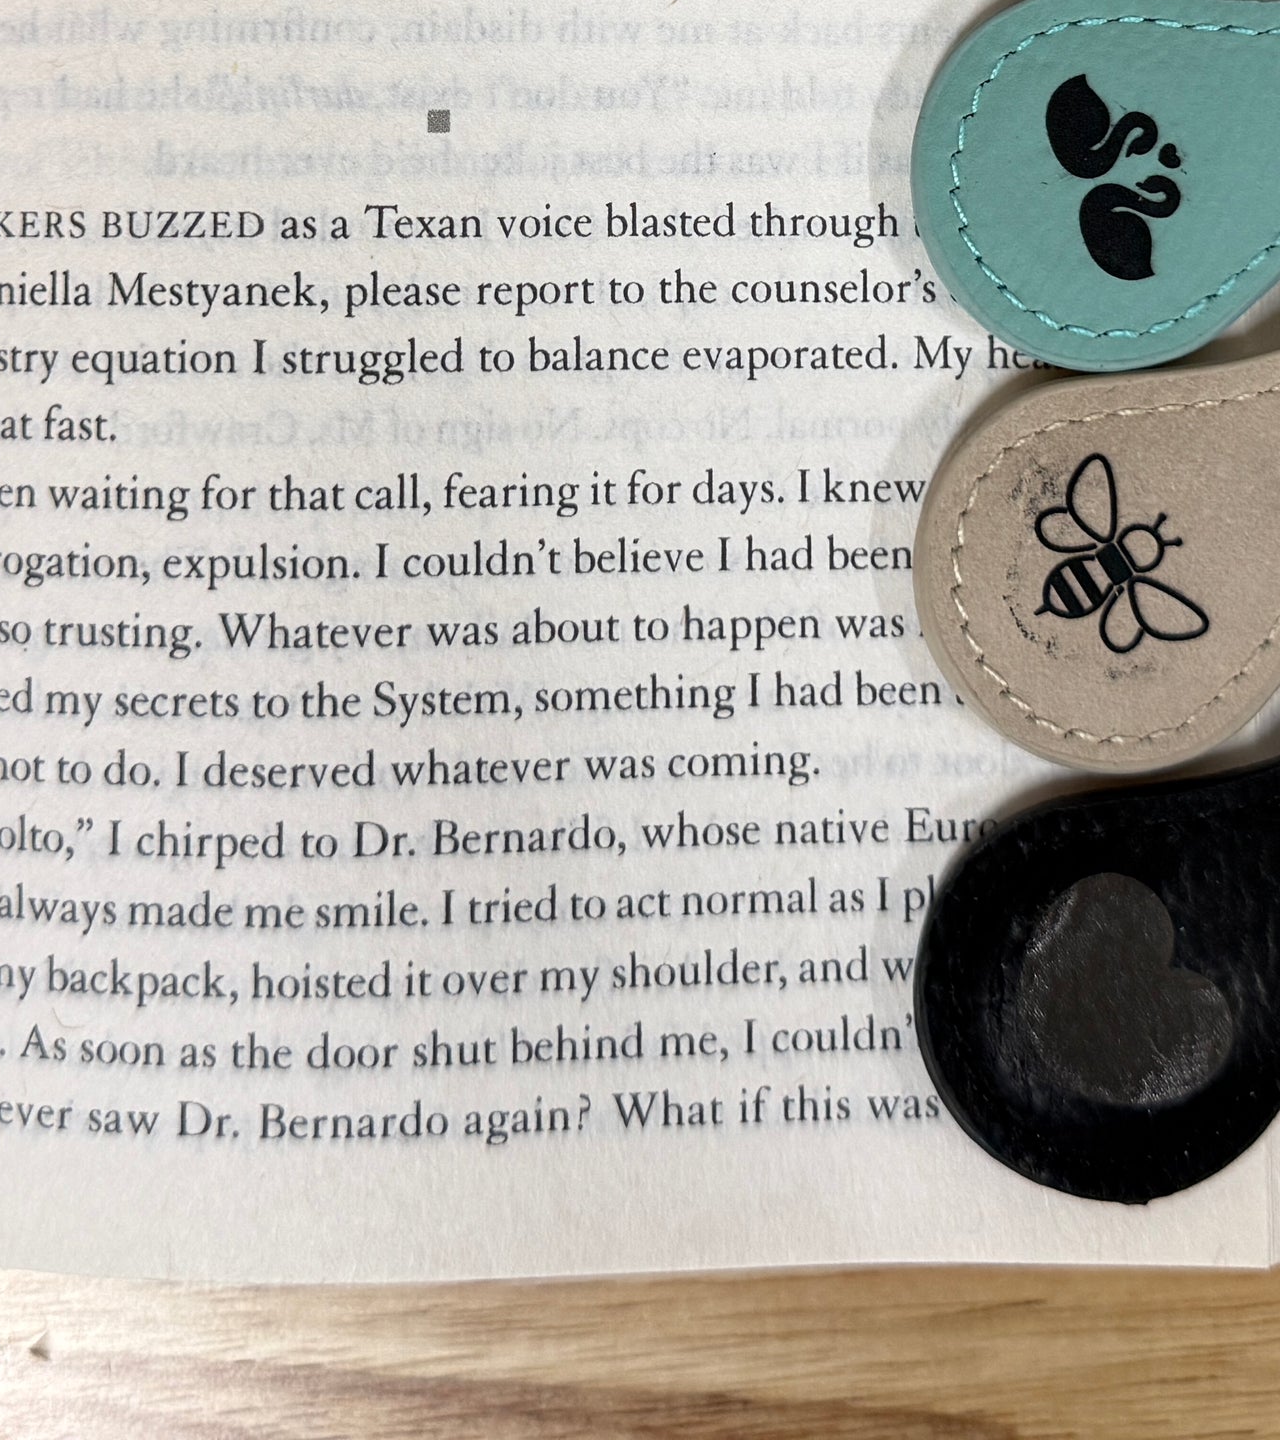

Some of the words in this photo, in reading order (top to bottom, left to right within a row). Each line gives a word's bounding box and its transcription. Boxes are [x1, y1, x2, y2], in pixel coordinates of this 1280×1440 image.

[101, 210, 265, 239] BUZZED
[280, 215, 317, 240] as
[330, 216, 351, 241] a
[363, 203, 483, 240] Texan
[496, 214, 592, 239] voice
[605, 201, 736, 238] blasted
[750, 201, 900, 249] through
[107, 270, 329, 318] Mestyanek,
[344, 270, 461, 319] please
[476, 278, 595, 317] report
[608, 277, 645, 305] to
[658, 267, 718, 305] the
[731, 267, 937, 305] counselor’s
[88, 1109, 160, 1135] saw
[177, 1101, 239, 1139] Dr.
[259, 1099, 449, 1140] Bernardo
[464, 1093, 591, 1147] again?
[612, 1089, 723, 1129] What
[739, 1085, 772, 1124] if
[782, 1084, 851, 1123] this
[867, 1095, 940, 1121] was
